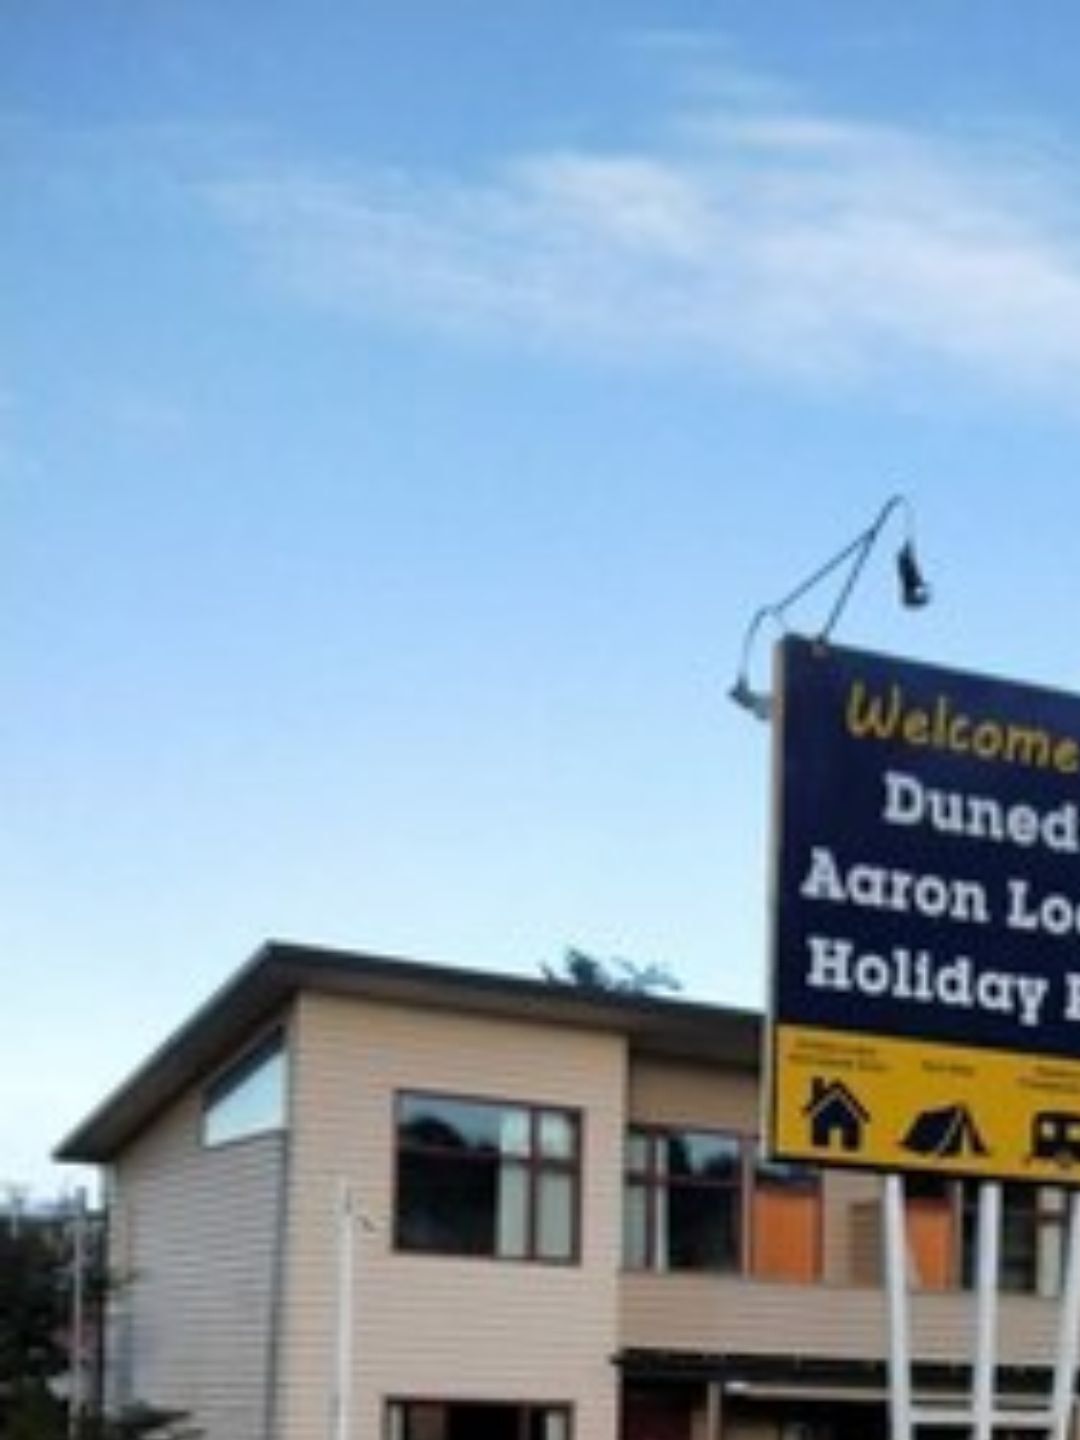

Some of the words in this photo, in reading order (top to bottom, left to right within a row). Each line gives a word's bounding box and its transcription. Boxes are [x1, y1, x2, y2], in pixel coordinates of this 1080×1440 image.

[846, 681, 1080, 773] Welcome
[800, 846, 989, 922] Aaron
[806, 937, 1049, 1026] Holiday
